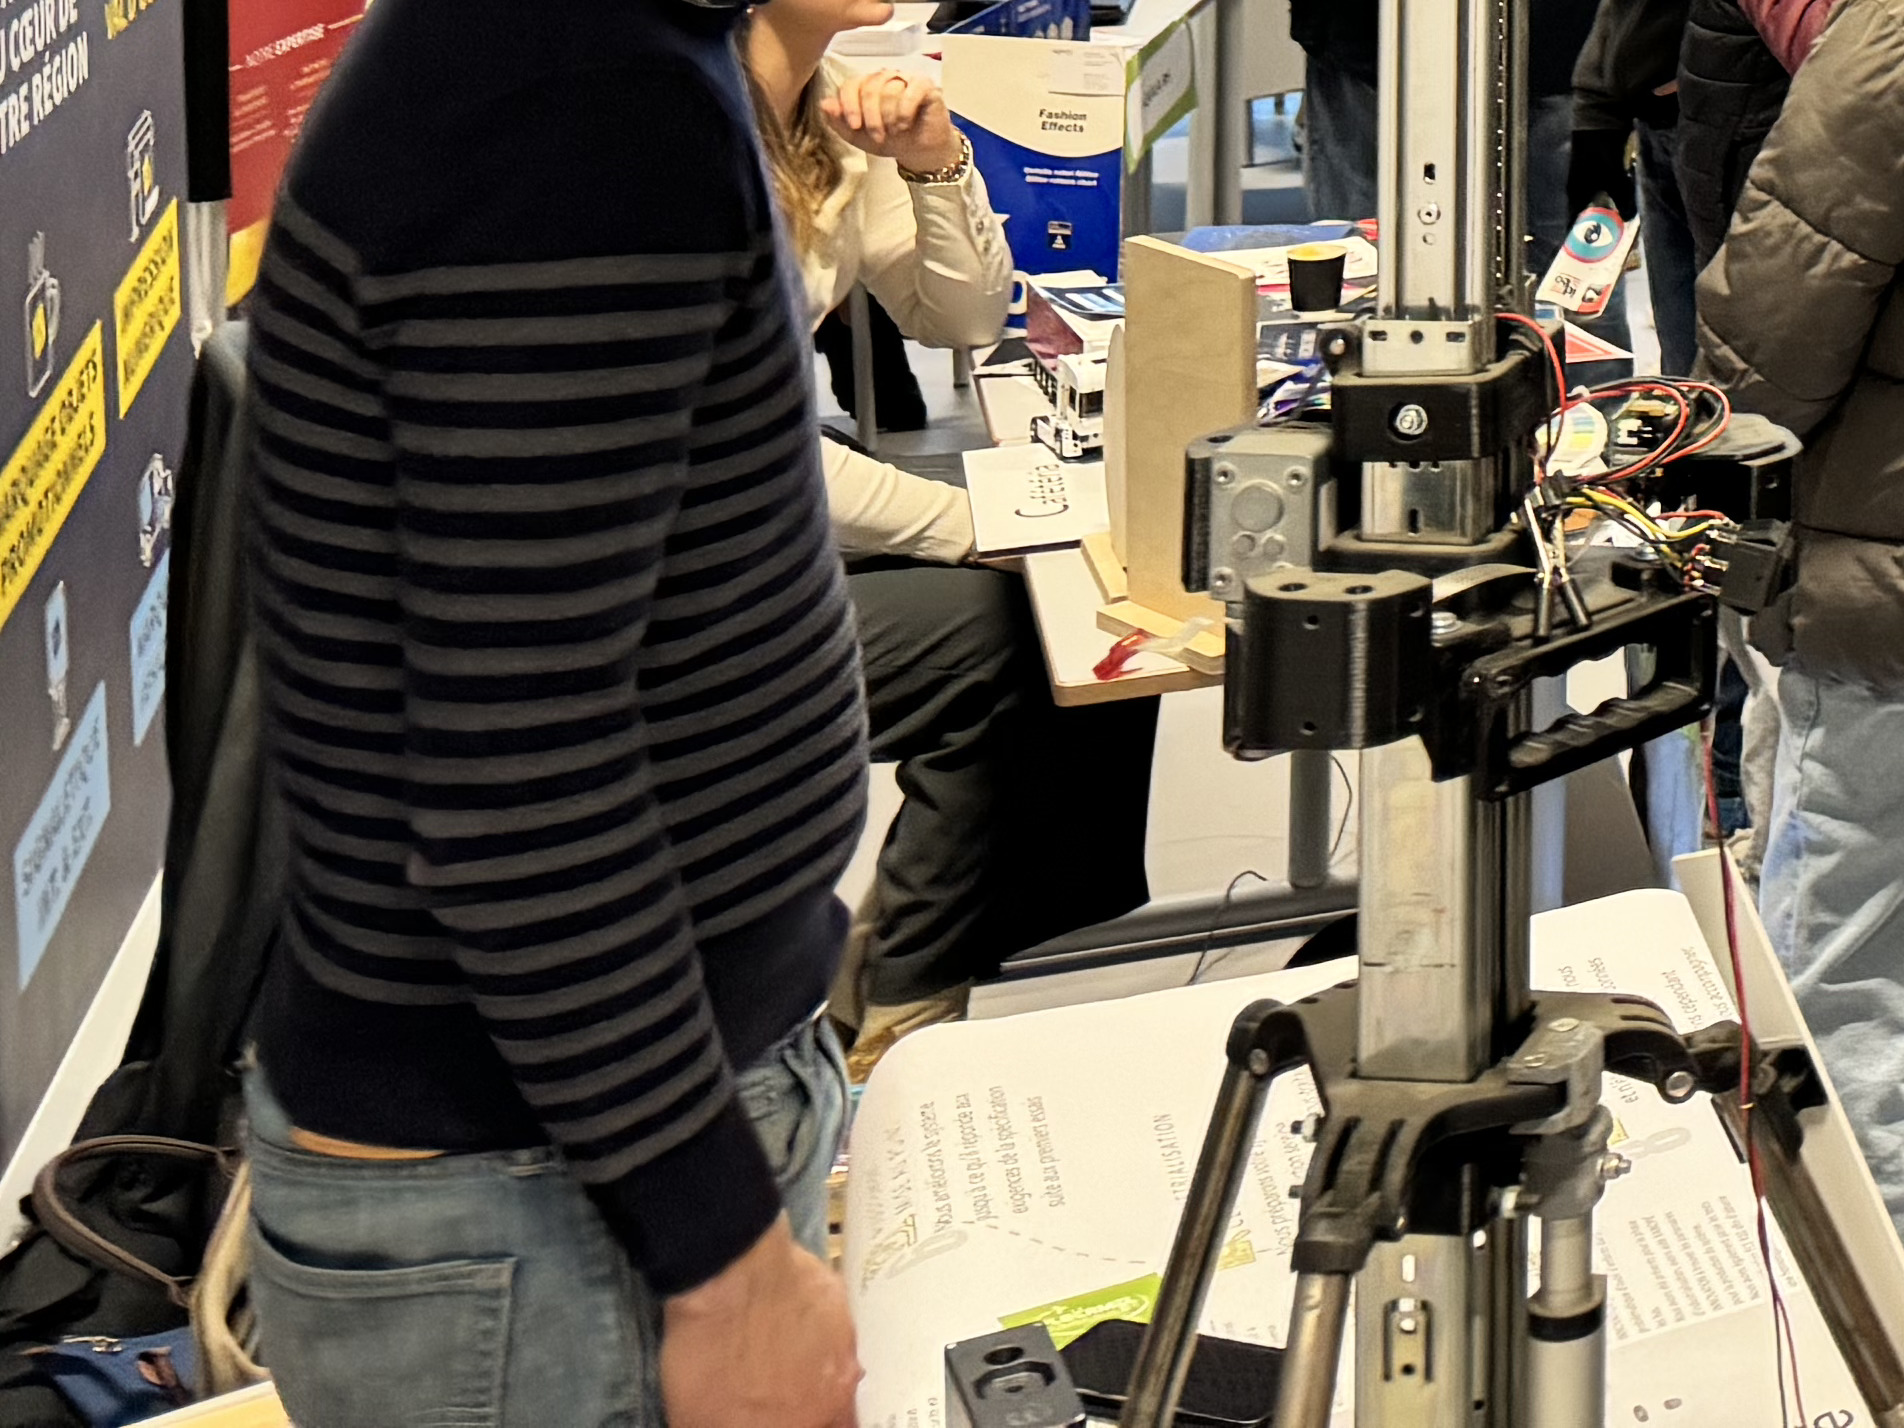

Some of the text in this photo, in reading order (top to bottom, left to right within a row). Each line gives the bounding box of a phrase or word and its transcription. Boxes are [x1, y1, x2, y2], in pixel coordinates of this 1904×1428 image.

[0, 31, 89, 155] TRE RÉGION
[1039, 108, 1087, 121] Fashion
[1041, 120, 1084, 133] Effects
